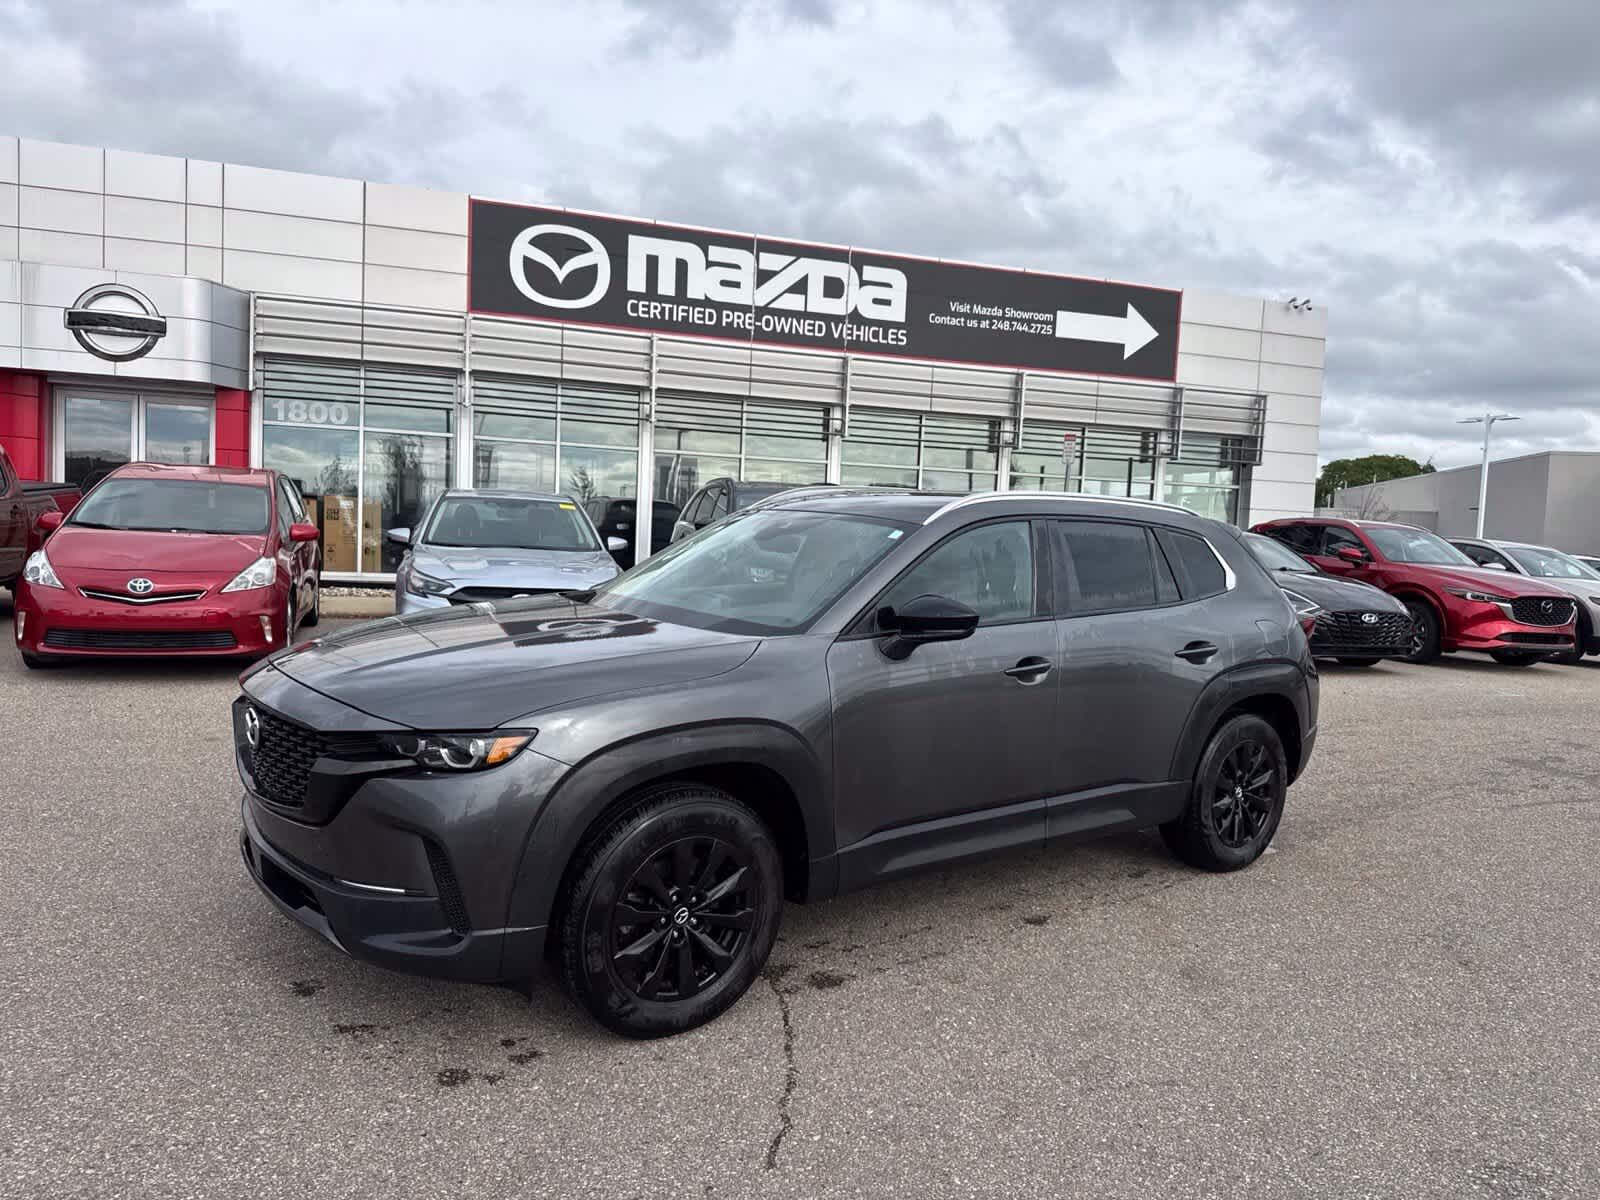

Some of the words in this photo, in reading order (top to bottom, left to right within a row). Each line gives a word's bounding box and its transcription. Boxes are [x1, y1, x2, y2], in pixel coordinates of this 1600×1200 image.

[627, 299, 717, 326] CERTIFIED
[722, 310, 826, 338] PRE-OWNED
[831, 321, 908, 346] VEHICLES
[949, 301, 971, 313] Visit
[973, 304, 1003, 317] Mazda
[1005, 307, 1054, 322] Showroom
[929, 313, 965, 327] Contact
[967, 319, 978, 328] us
[980, 319, 990, 329] at
[991, 319, 1053, 335] 248.744.2725
[272, 400, 349, 425] 1800
